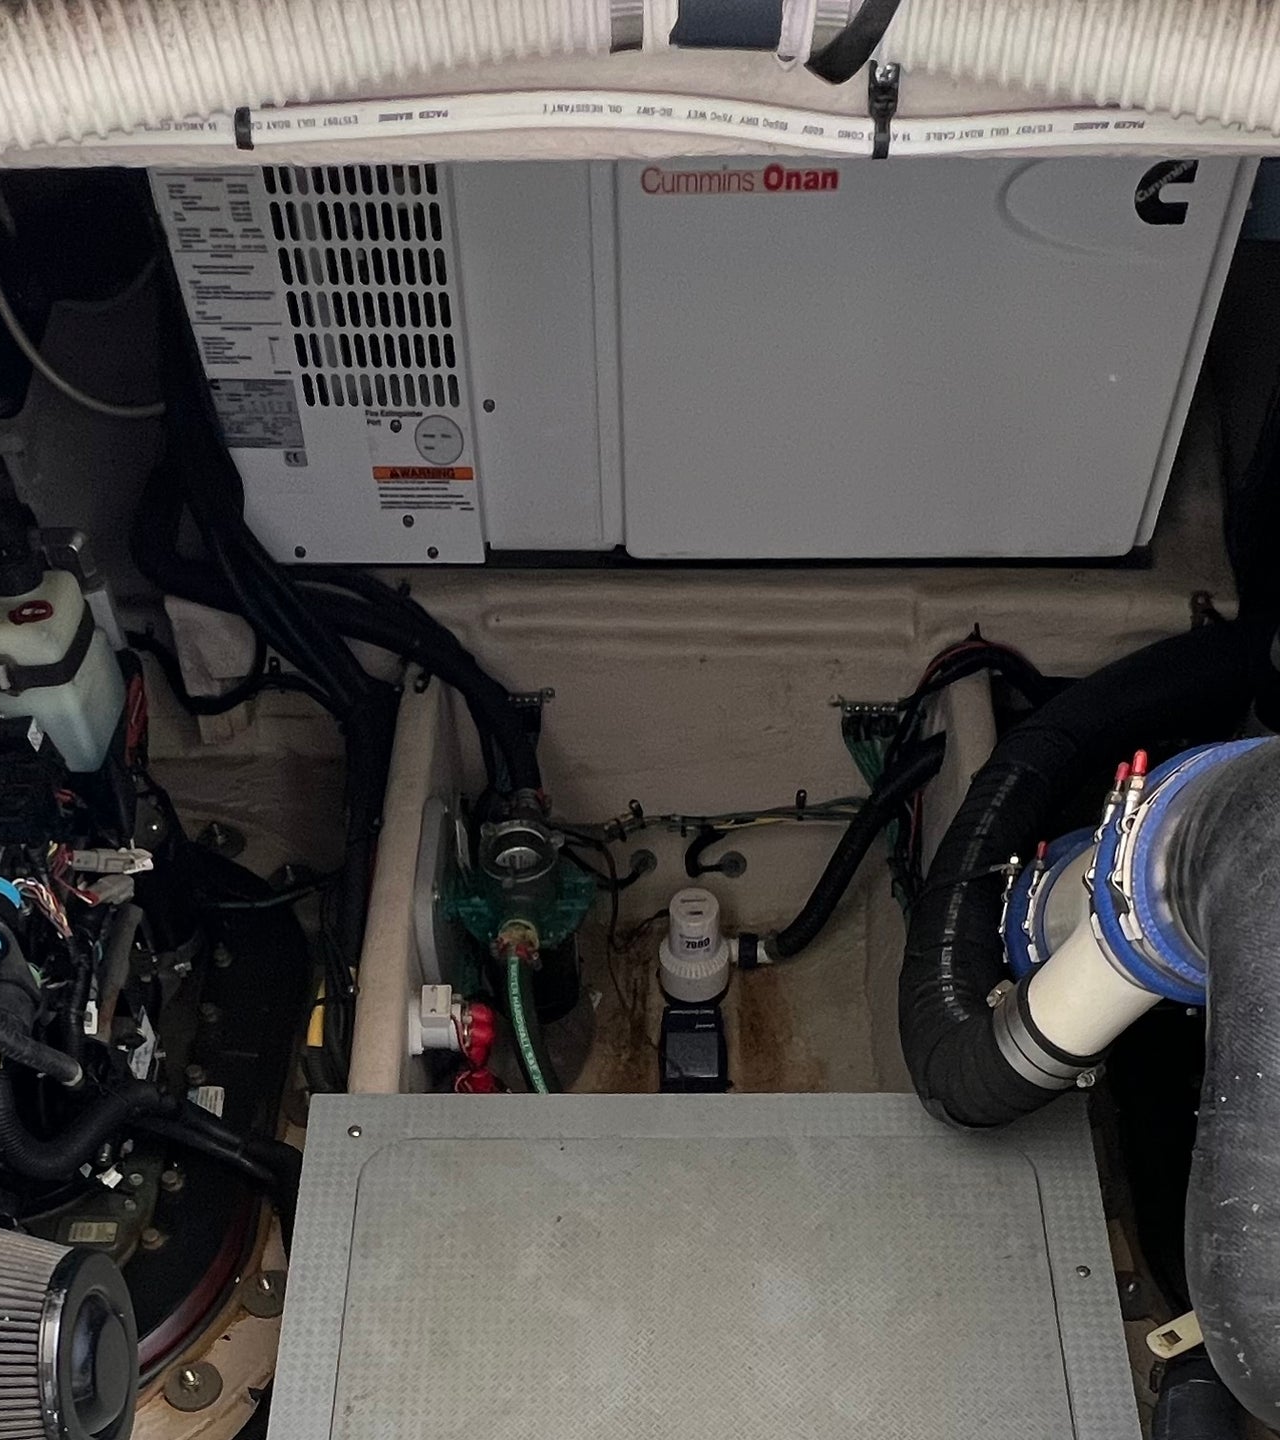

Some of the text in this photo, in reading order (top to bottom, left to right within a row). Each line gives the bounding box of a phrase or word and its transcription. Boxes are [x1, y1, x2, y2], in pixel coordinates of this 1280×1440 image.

[552, 104, 604, 114] RESISTANT
[687, 110, 707, 120] WET
[267, 119, 291, 129] BOAT
[925, 131, 955, 141] CABLE
[959, 129, 984, 140] BOAT
[641, 163, 839, 195] Cummins Onan
[401, 468, 455, 479] WARNING
